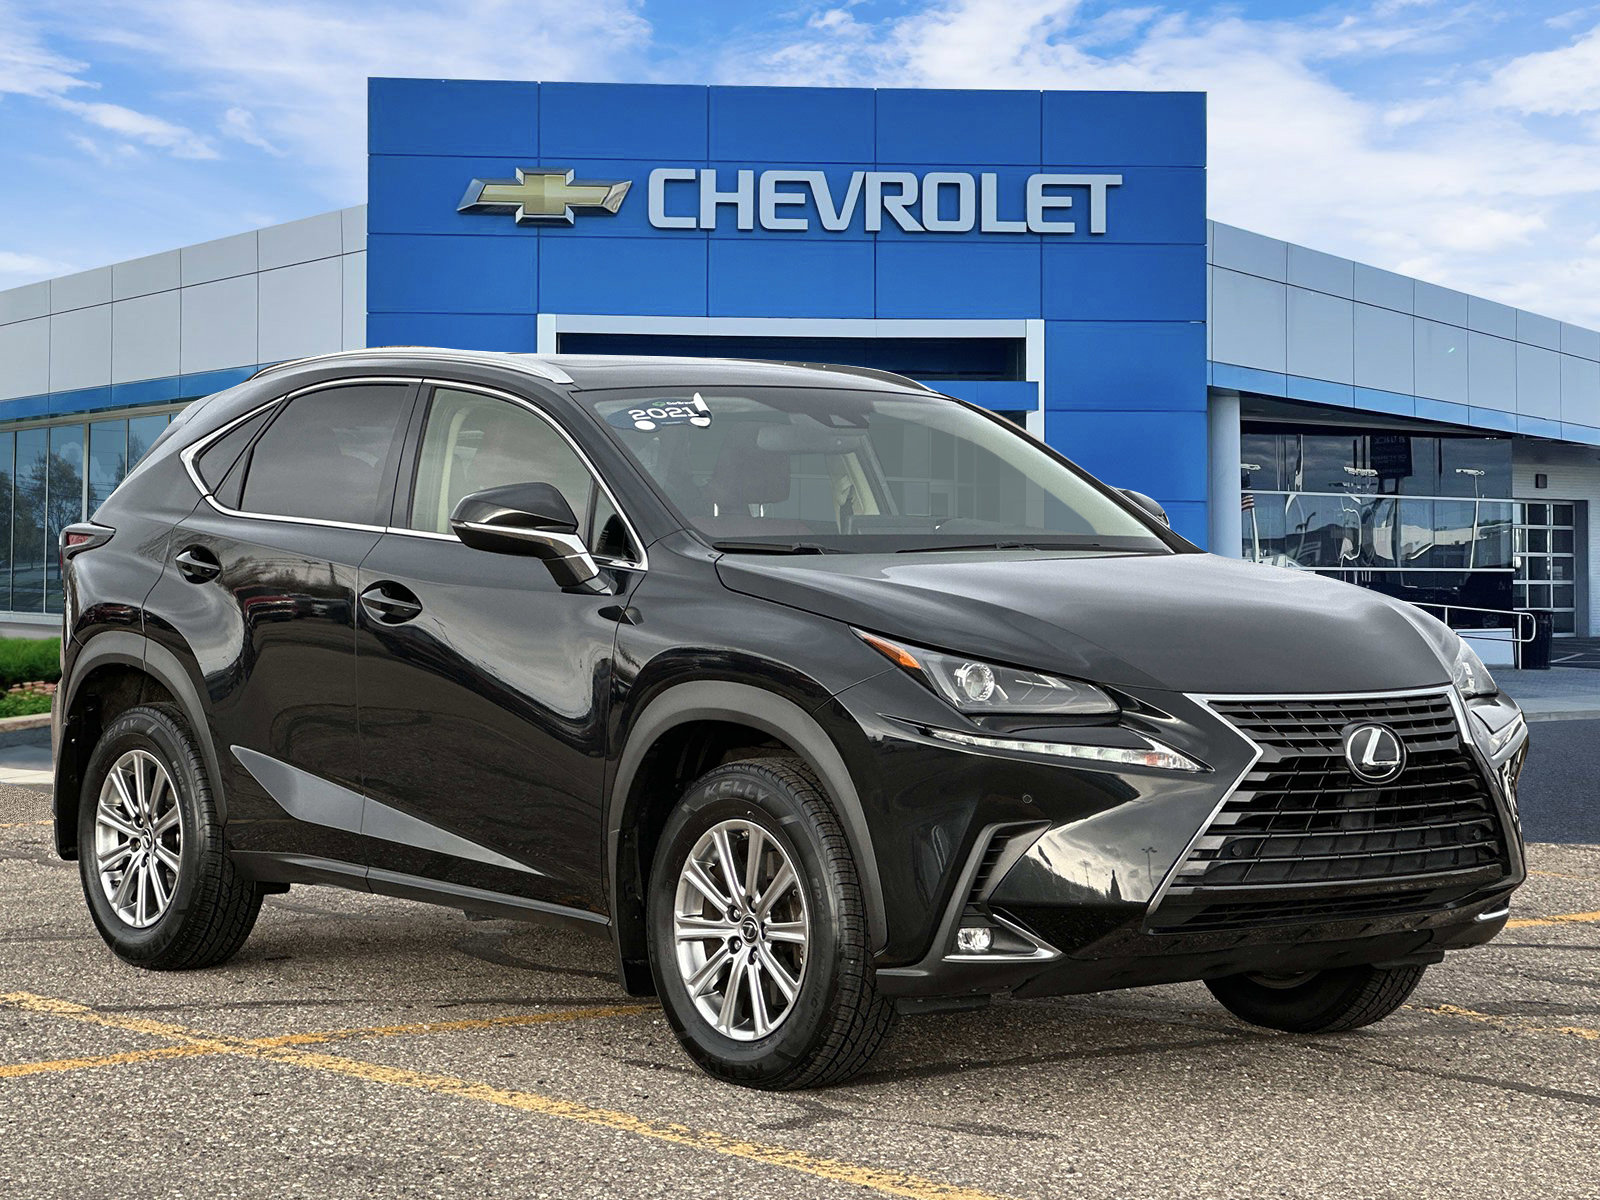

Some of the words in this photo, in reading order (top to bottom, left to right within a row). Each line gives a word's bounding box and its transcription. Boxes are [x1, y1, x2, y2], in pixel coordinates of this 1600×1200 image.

[648, 168, 1123, 233] CHEVROLET
[628, 407, 699, 420] 2021
[703, 780, 770, 803] KELLY
